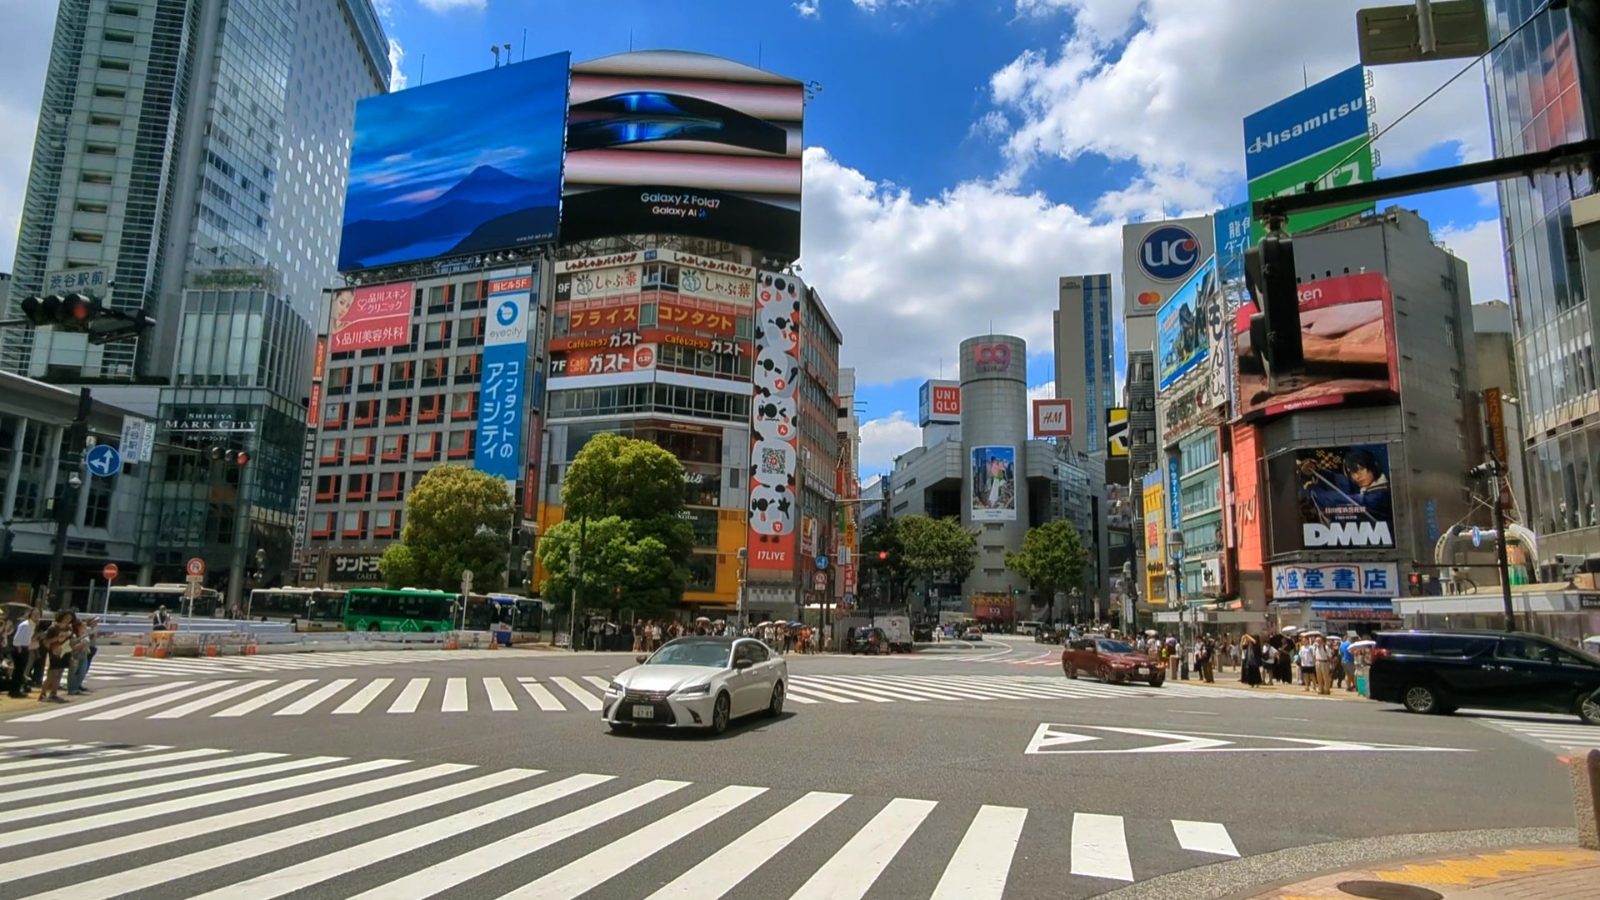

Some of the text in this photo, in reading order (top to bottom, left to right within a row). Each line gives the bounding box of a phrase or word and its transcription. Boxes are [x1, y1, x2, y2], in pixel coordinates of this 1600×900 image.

[1247, 97, 1363, 154] Hisamitsu
[641, 193, 720, 208] Galaxy Z Fold7
[652, 206, 686, 218] Galaxy
[1228, 216, 1250, 239] 龍角
[565, 253, 638, 271] しゃぶしゃぶバイキング
[673, 253, 752, 275] しゃぶしゃぶバイキング
[50, 271, 103, 289] 渋谷駅前
[558, 283, 570, 293] 9F
[595, 271, 637, 289] しゃぶ葉
[705, 276, 752, 297] しゃぶ葉
[367, 290, 408, 303] 品川スキン
[1298, 288, 1323, 302] ten
[367, 301, 402, 314] クリニック
[571, 307, 636, 328] プライス
[659, 305, 732, 330] コンタクト
[341, 326, 403, 345] 品川美容外科
[490, 328, 522, 340] eyecity
[609, 332, 643, 347] ガスト
[711, 340, 744, 356] ガスト
[552, 360, 567, 372] 7F
[589, 353, 630, 373] ガスト
[936, 390, 956, 400] UNI
[482, 363, 504, 459] アイシティ
[500, 361, 519, 458] コンタクトの
[936, 401, 957, 412] QLO
[165, 420, 257, 429] MARK CITY
[1043, 411, 1062, 424] H&M
[1303, 521, 1392, 547] DMM
[757, 550, 786, 561] 17LIVE
[336, 556, 380, 572] サンドラ
[1276, 567, 1388, 591] 大盛堂書店
